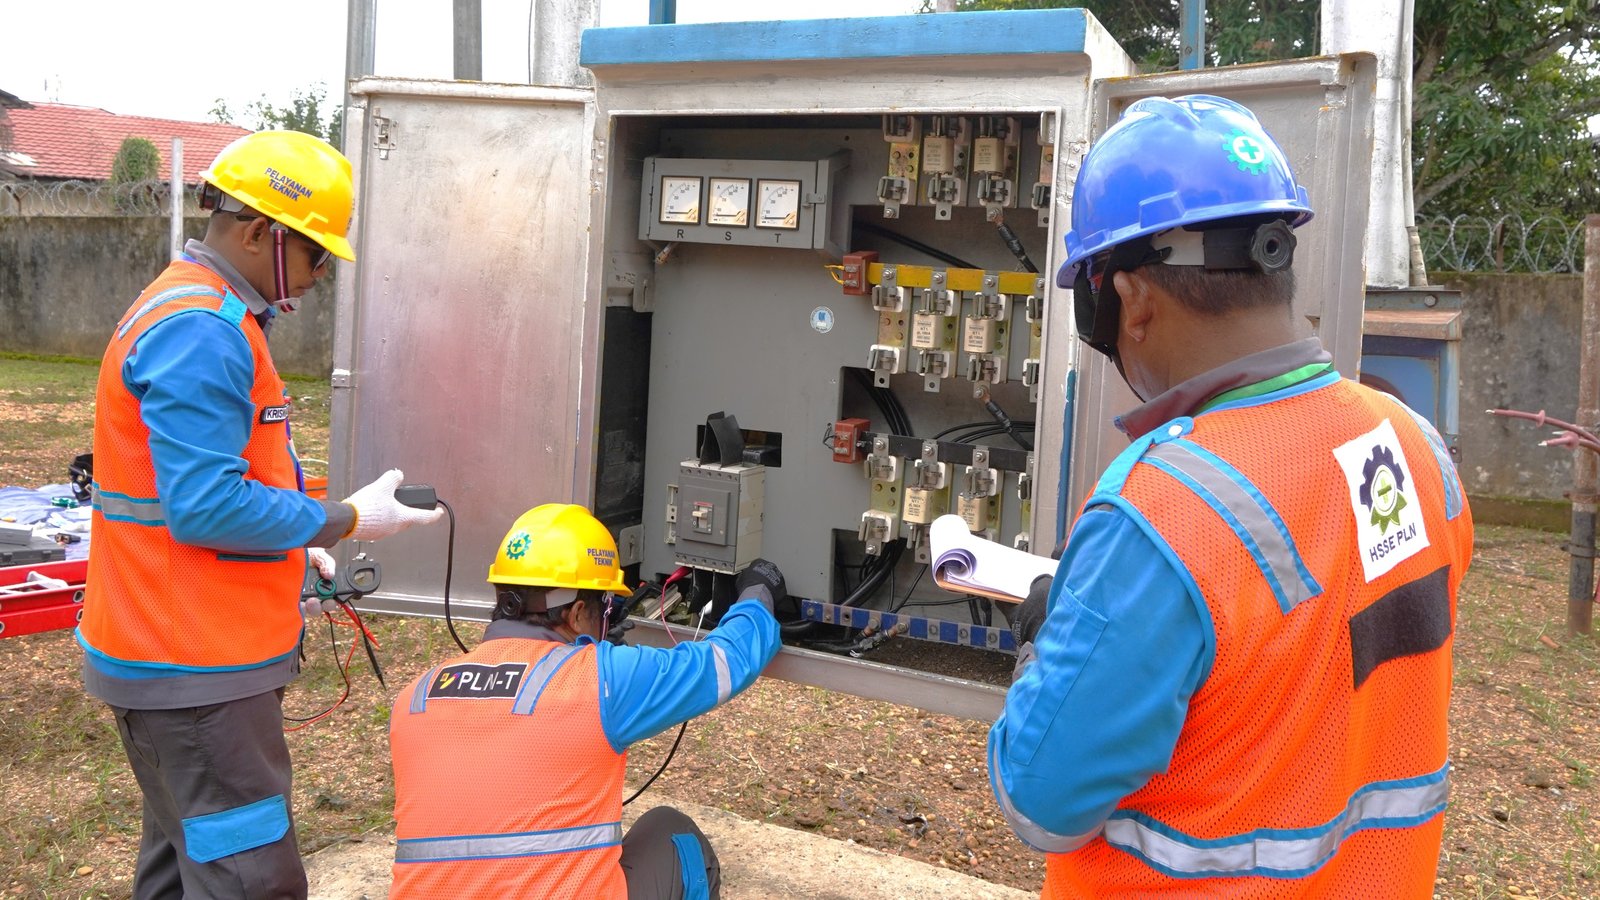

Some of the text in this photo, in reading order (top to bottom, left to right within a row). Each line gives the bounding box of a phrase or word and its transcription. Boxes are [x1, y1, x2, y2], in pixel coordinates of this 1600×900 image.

[265, 168, 313, 199] PELAYANAN
[269, 179, 300, 202] TEKNIK
[677, 229, 782, 243] R S T
[1369, 522, 1416, 562] HSSE PLN
[587, 548, 615, 558] PELAYANAN
[594, 557, 613, 567] TEKNIK
[457, 671, 520, 691] PLN-T
